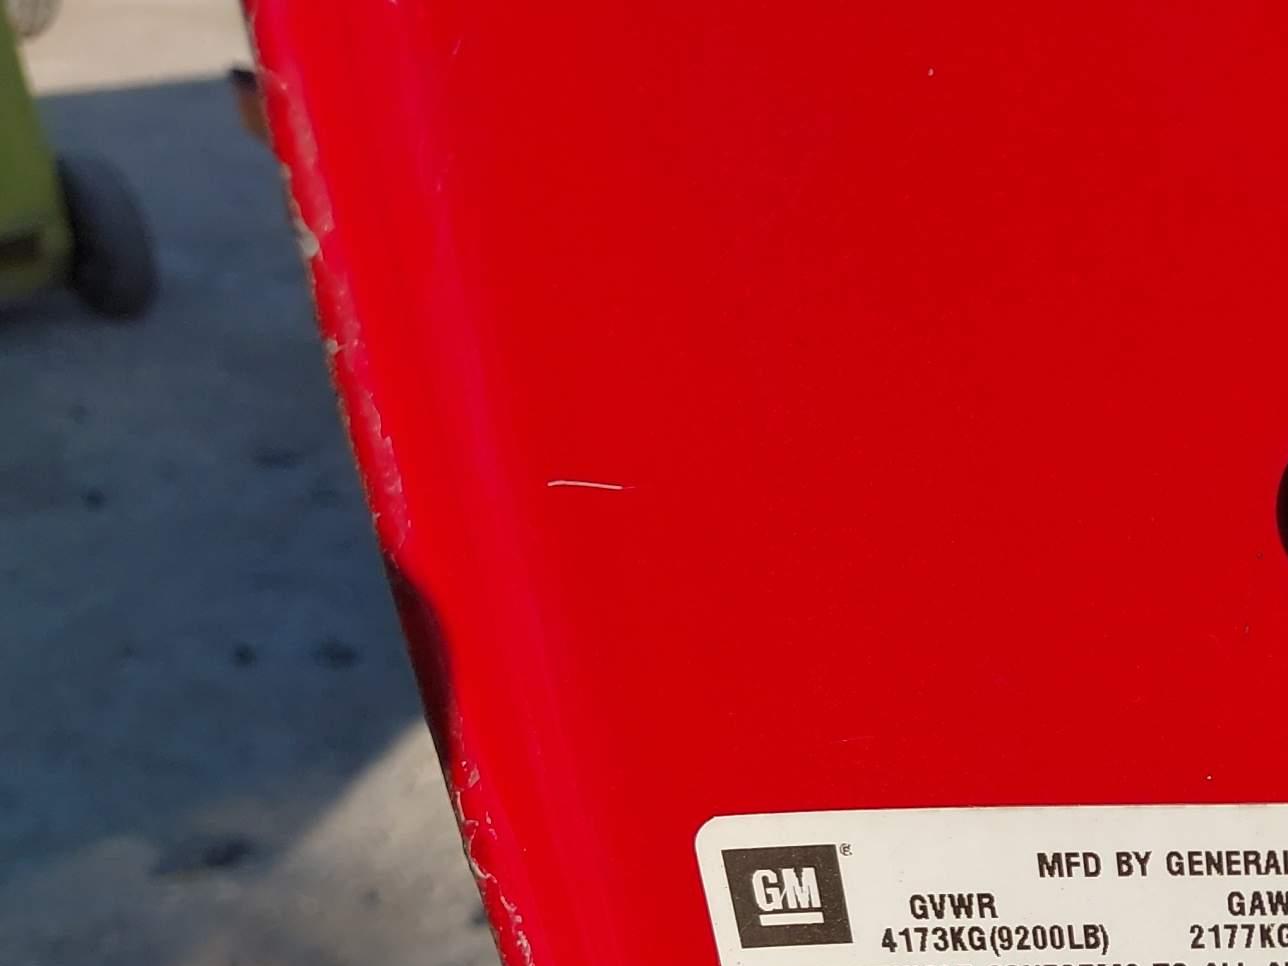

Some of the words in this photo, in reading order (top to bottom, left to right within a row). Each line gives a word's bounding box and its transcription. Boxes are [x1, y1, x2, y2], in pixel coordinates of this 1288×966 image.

[1037, 852, 1101, 877] MFD
[1116, 852, 1151, 876] BY
[752, 868, 821, 911] GM
[910, 893, 998, 919] GVWR
[882, 925, 1108, 957] 4173KG(9200LB)
